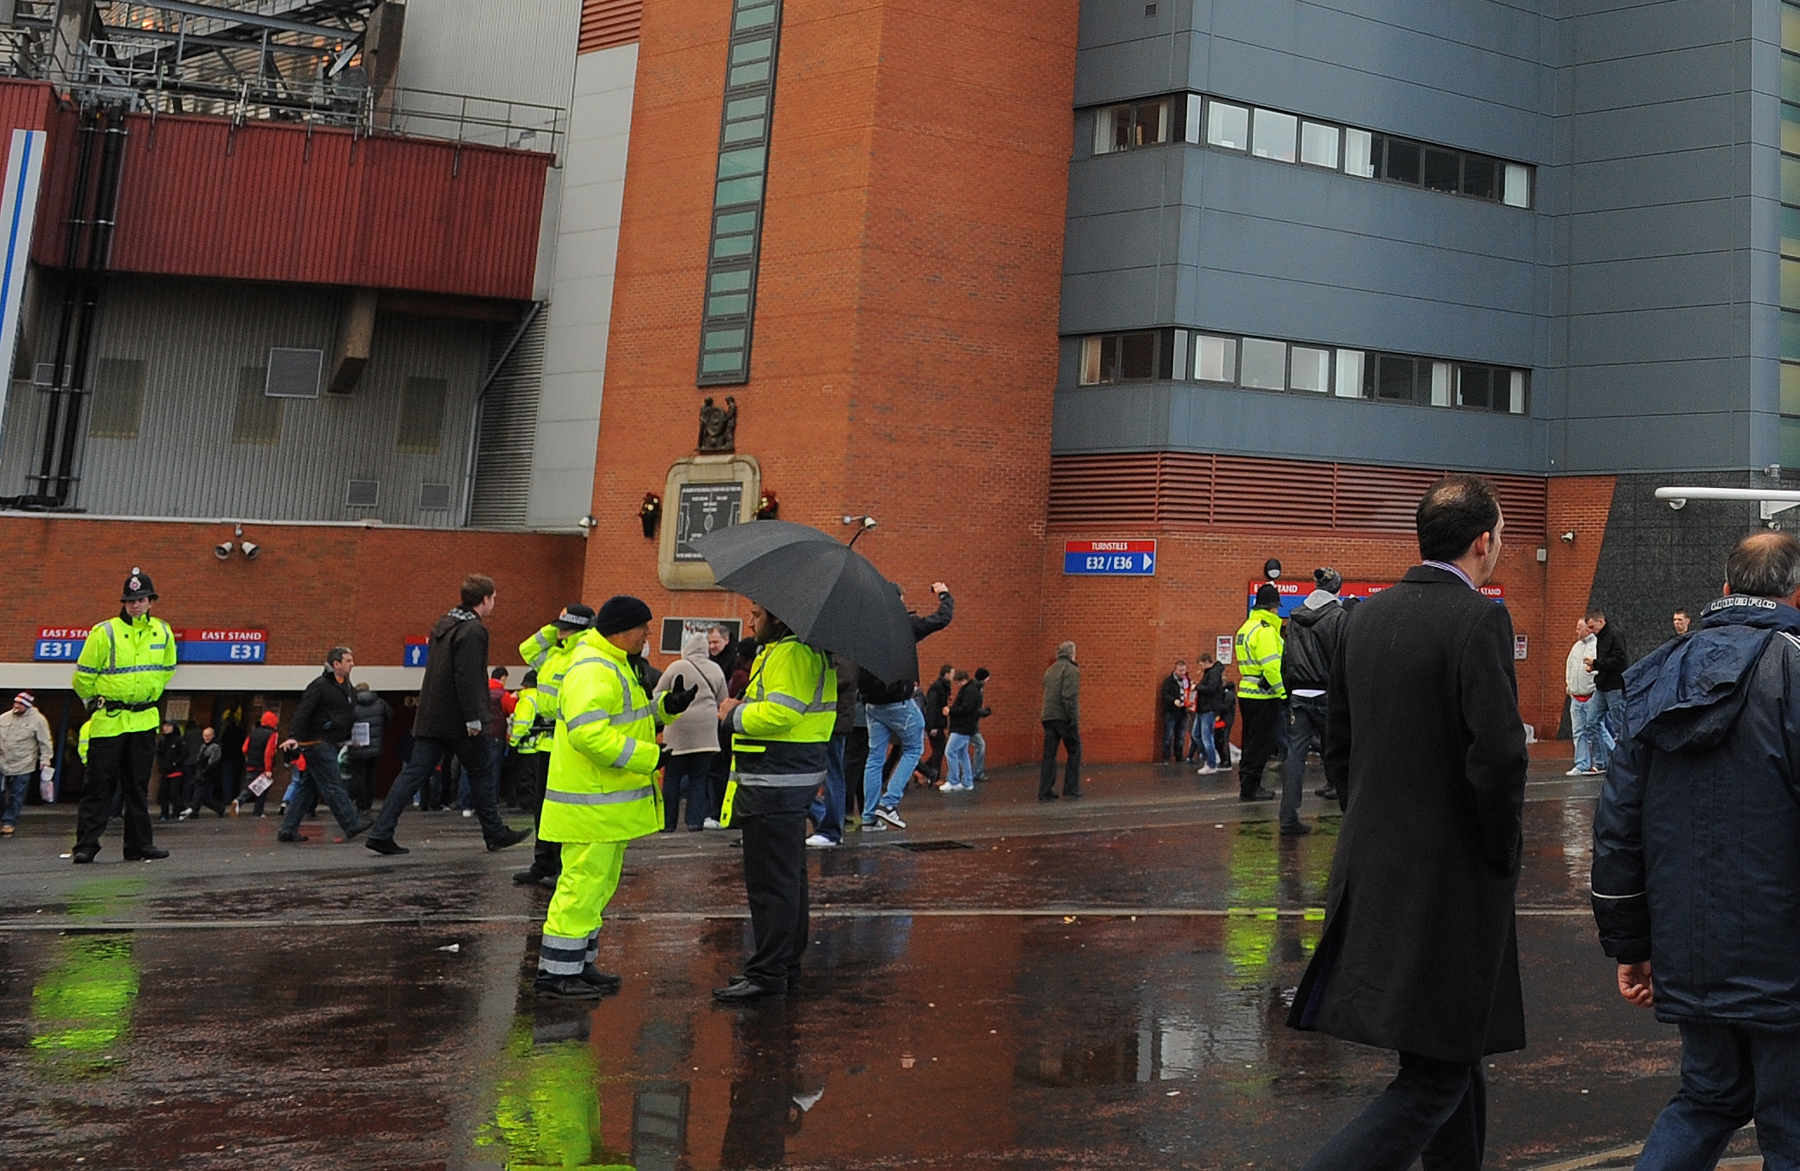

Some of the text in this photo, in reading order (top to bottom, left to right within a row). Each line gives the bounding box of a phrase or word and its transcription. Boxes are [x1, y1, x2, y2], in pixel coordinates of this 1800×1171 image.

[1085, 556, 1105, 570] E32
[1113, 556, 1133, 570] E36
[42, 629, 93, 638] EAST STA
[201, 631, 262, 641] EAST STAND
[39, 642, 72, 657] E31
[230, 645, 260, 660] E31
